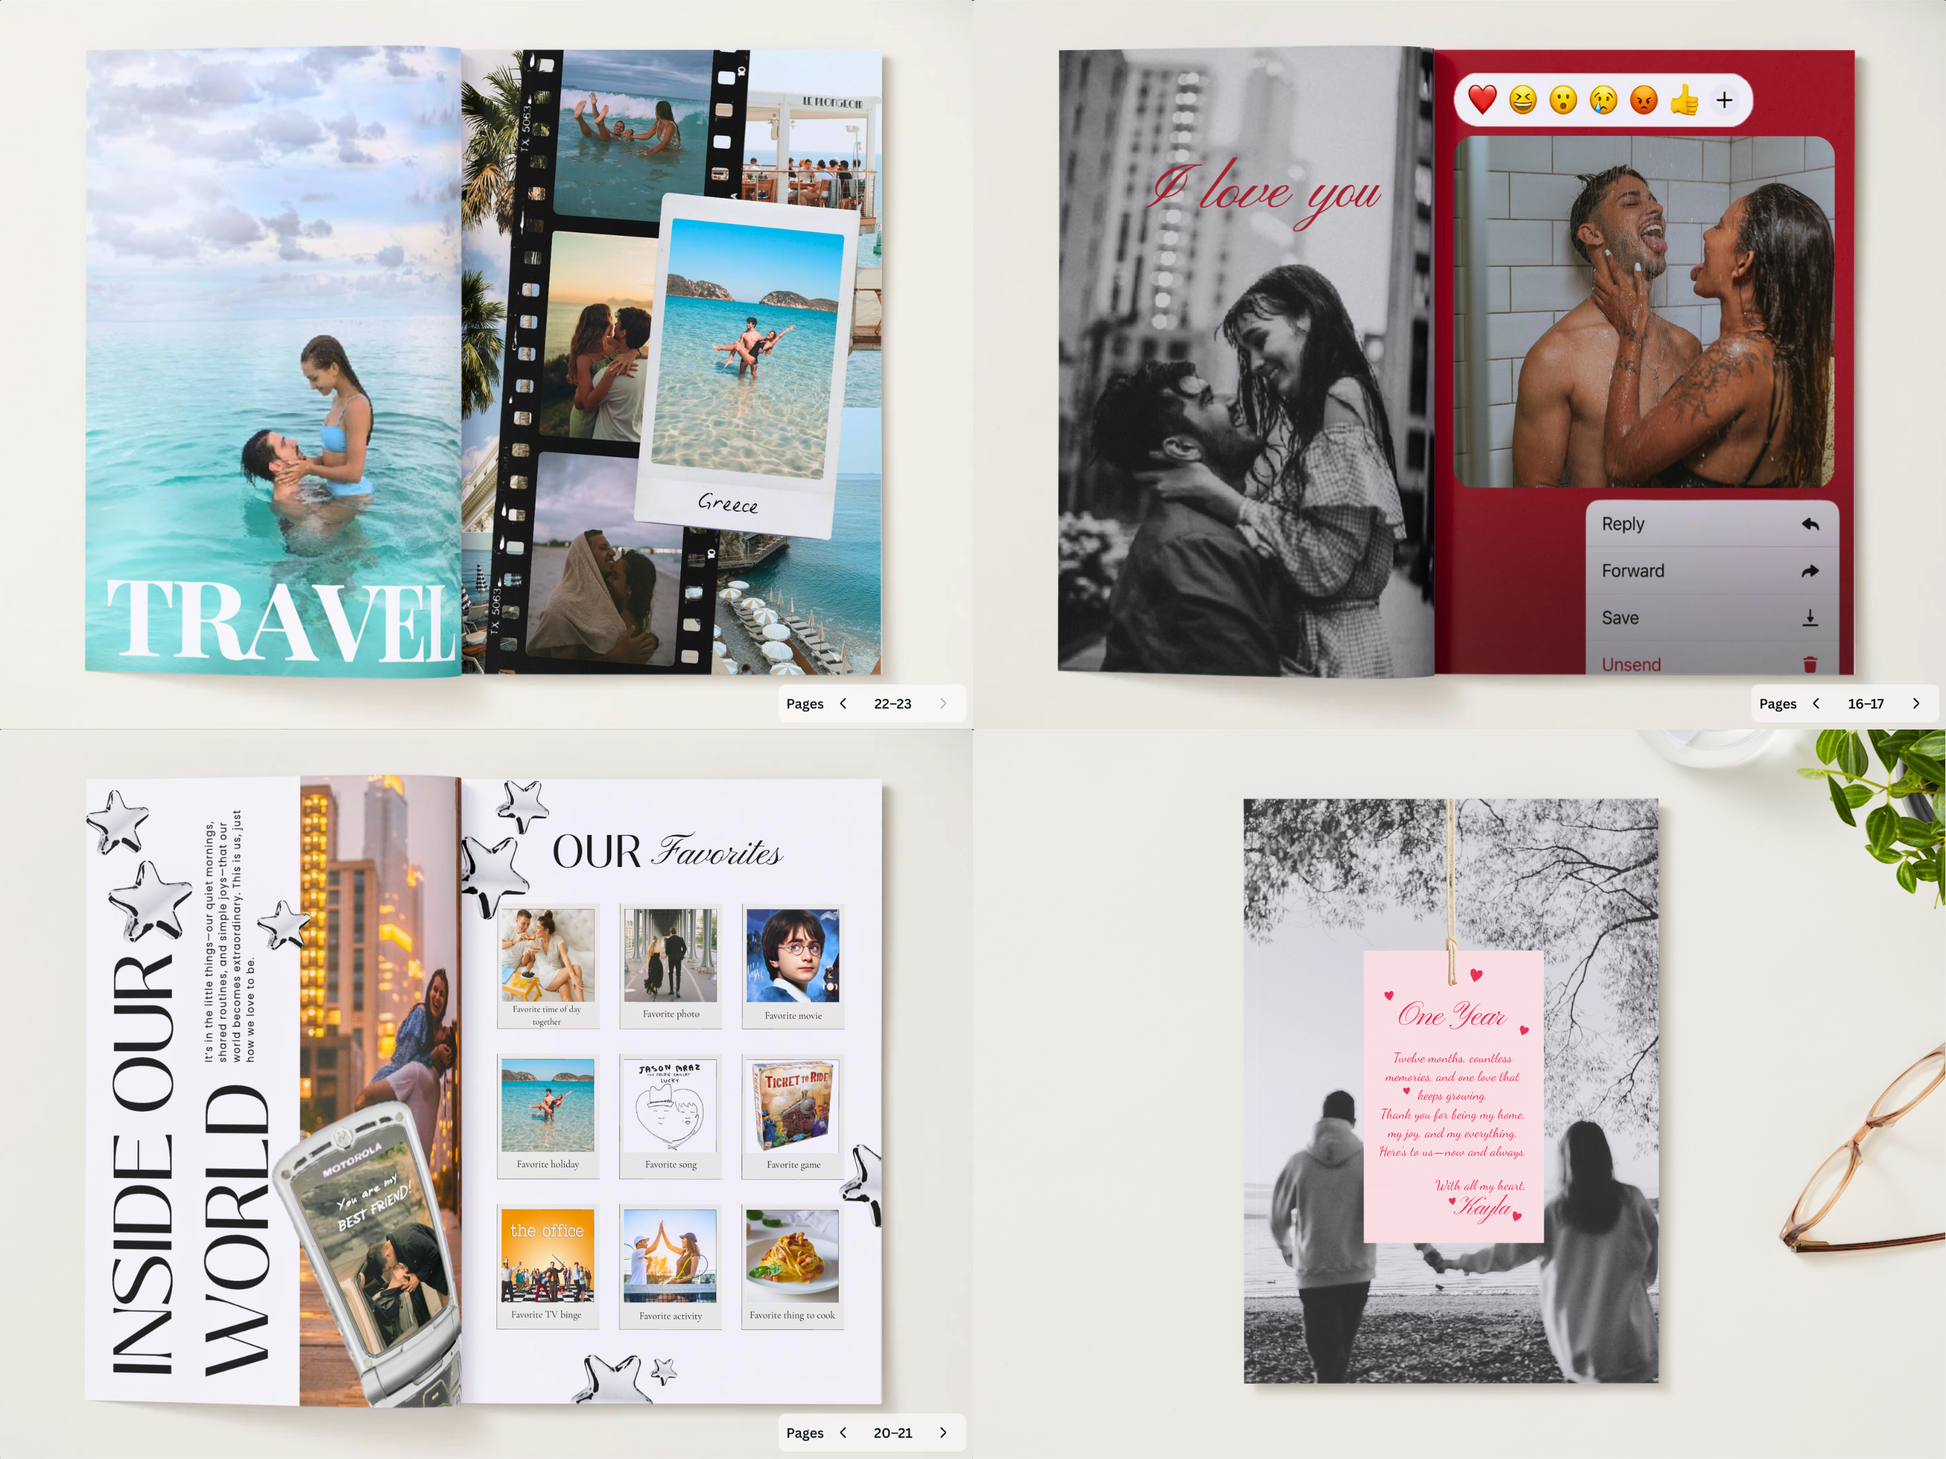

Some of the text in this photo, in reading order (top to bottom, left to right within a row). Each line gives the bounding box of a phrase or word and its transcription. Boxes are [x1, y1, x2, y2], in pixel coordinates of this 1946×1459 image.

[803, 96, 864, 109] LE PLONGEOIR
[520, 105, 532, 153] TX 5063
[1146, 156, 1381, 232] I love you
[698, 491, 759, 514] Greece
[1603, 516, 1645, 534] Reply
[1603, 563, 1664, 577] Forward
[490, 587, 502, 636] TX 5063
[1603, 610, 1639, 625] Save
[107, 579, 456, 664] TRAVEL
[1602, 656, 1662, 672] Unsend
[219, 822, 228, 841] our
[203, 821, 217, 877] mornings,
[554, 832, 784, 868] OUR Favorites
[204, 881, 216, 911] quiet
[217, 903, 230, 941] simple
[231, 809, 244, 1063] world becomes extraordinary. This is us, just
[217, 945, 228, 967] and
[203, 980, 214, 1007] little
[217, 970, 229, 1020] routines,
[245, 957, 255, 1063] how we love to be.
[512, 1004, 582, 1016] Favorite time of day
[643, 1008, 701, 1021] Favorite photo
[764, 1011, 823, 1020] Favorite movie
[1399, 1001, 1507, 1029] One Year
[204, 1010, 214, 1029] the
[532, 1017, 562, 1028] together
[203, 1032, 213, 1043] in
[217, 1023, 228, 1063] shared
[1394, 1051, 1426, 1064] Twelve
[1468, 1051, 1512, 1064] countless
[639, 1064, 700, 1074] JASON MRAZ
[1384, 1072, 1432, 1083] memories,
[1435, 1070, 1457, 1082] and
[1476, 1070, 1497, 1082] love
[1498, 1070, 1521, 1082] that
[765, 1075, 800, 1088] TICKET
[811, 1072, 828, 1082] RIDE
[1417, 1089, 1487, 1104] keeps growing.
[1381, 1107, 1412, 1121] Thank
[1413, 1112, 1432, 1123] you
[1433, 1108, 1447, 1122] for
[1451, 1108, 1477, 1123] being
[1479, 1113, 1495, 1123] my
[1387, 1131, 1403, 1142] my
[1424, 1126, 1446, 1139] and
[1446, 1131, 1462, 1142] my
[1464, 1127, 1516, 1141] everything.
[322, 1142, 383, 1178] MOTOROLA
[1409, 1146, 1420, 1157] to
[1467, 1145, 1489, 1157] and
[1489, 1145, 1526, 1160] always.
[112, 954, 174, 1374] INSIDE OUR
[517, 1159, 580, 1172] Favorite holiday
[645, 1160, 698, 1172] Favorite song
[767, 1160, 822, 1172] Favorite game
[336, 1173, 398, 1210] You are my
[1435, 1179, 1461, 1192] With
[1463, 1179, 1480, 1191] all
[1479, 1184, 1495, 1194] my
[338, 1179, 412, 1232] BEST FRIEND!
[1453, 1194, 1512, 1225] Kayla
[204, 1085, 270, 1377] WORLD
[510, 1223, 584, 1238] the office
[511, 1309, 582, 1322] Favorite TV binge
[639, 1311, 703, 1323] Favorite activity
[749, 1310, 782, 1320] Favorite
[783, 1310, 805, 1323] thing
[816, 1310, 836, 1320] cook
